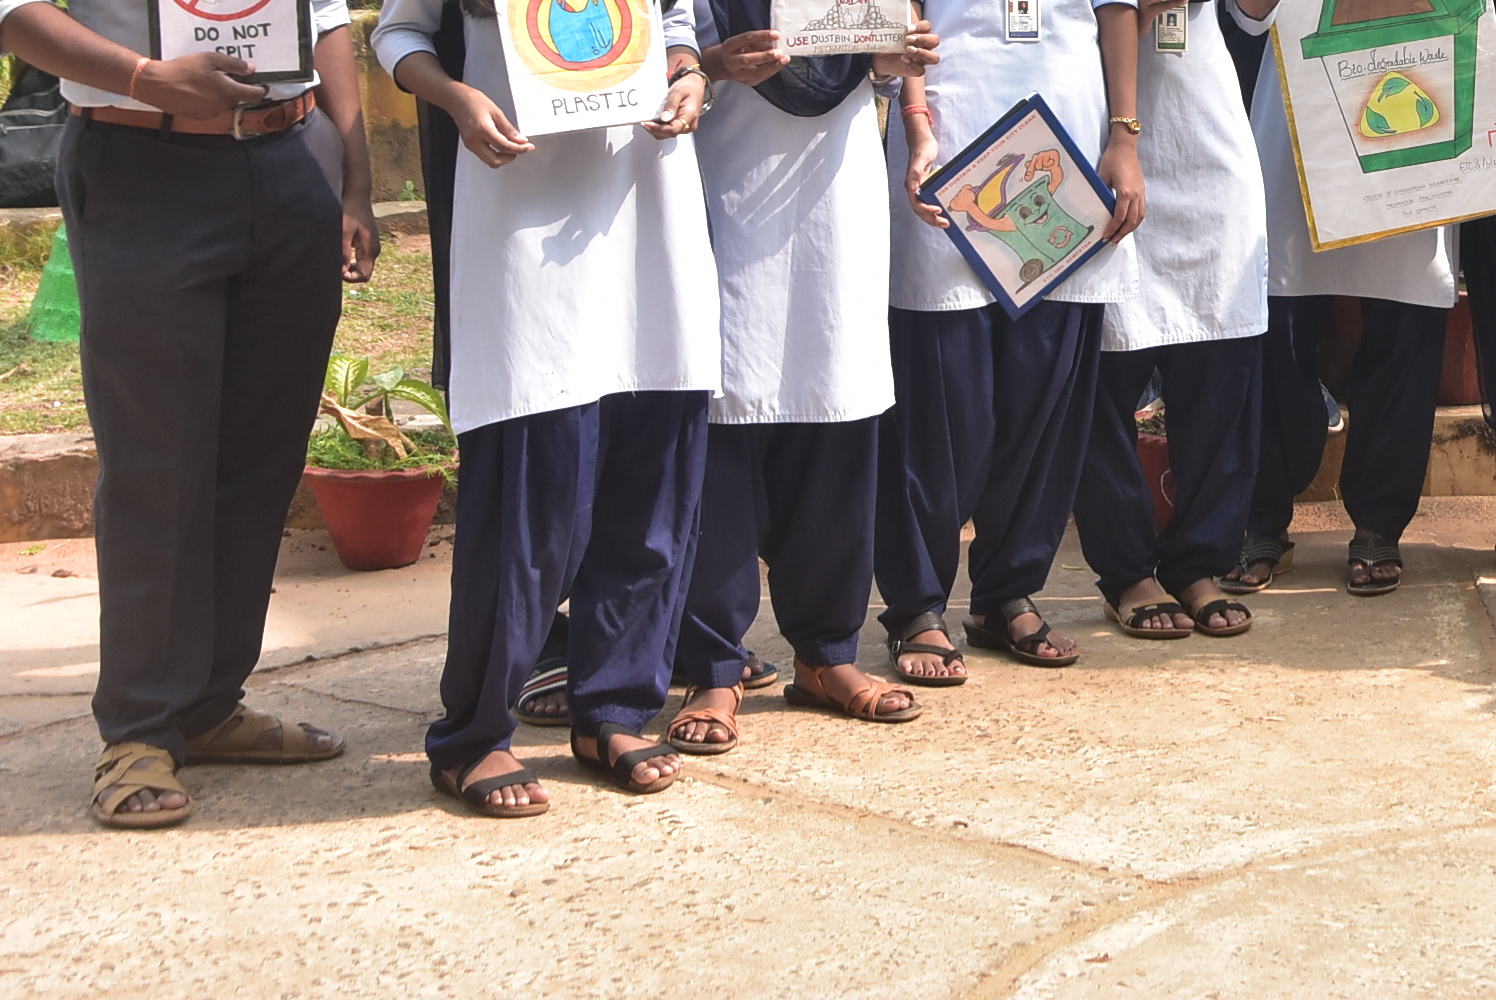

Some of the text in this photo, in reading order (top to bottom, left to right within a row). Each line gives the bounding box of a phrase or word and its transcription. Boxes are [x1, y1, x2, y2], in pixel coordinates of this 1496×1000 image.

[194, 22, 271, 42] DO NOT
[786, 36, 810, 47] USE
[875, 33, 903, 42] LITTER
[215, 44, 256, 59] SPIT
[1419, 47, 1448, 62] Waste
[551, 89, 639, 116] PLASTIC
[937, 186, 949, 197] USE
[949, 168, 972, 188] DUSTBIN
[976, 151, 991, 165] KEEP
[991, 139, 1006, 153] YOUR
[1005, 129, 1018, 141] CITY
[1018, 114, 1036, 130] CLEAN
[1459, 160, 1474, 172] ETC
